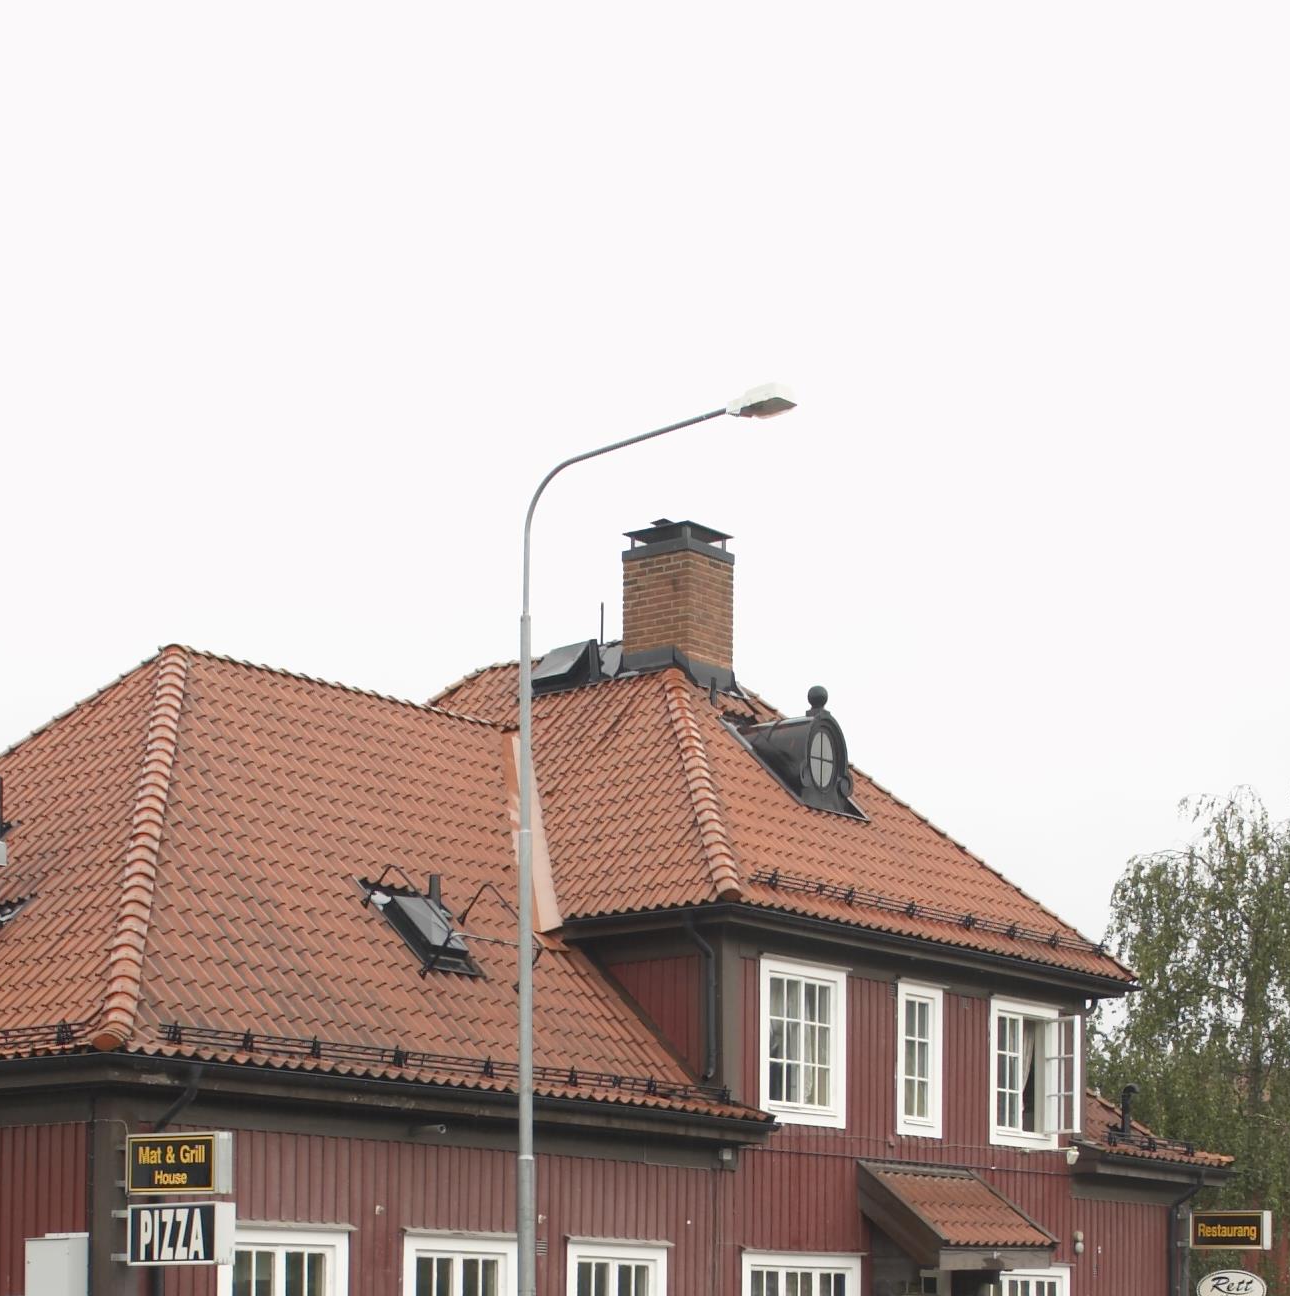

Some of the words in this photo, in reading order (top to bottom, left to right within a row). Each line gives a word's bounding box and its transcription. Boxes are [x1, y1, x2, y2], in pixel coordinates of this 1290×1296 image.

[138, 1145, 162, 1165] Mat
[166, 1145, 176, 1164] &
[180, 1144, 206, 1164] Grill
[154, 1170, 188, 1185] House
[139, 1207, 205, 1261] PIZZA
[1197, 1222, 1257, 1241] Restaurang
[1210, 1276, 1254, 1295] Rett
